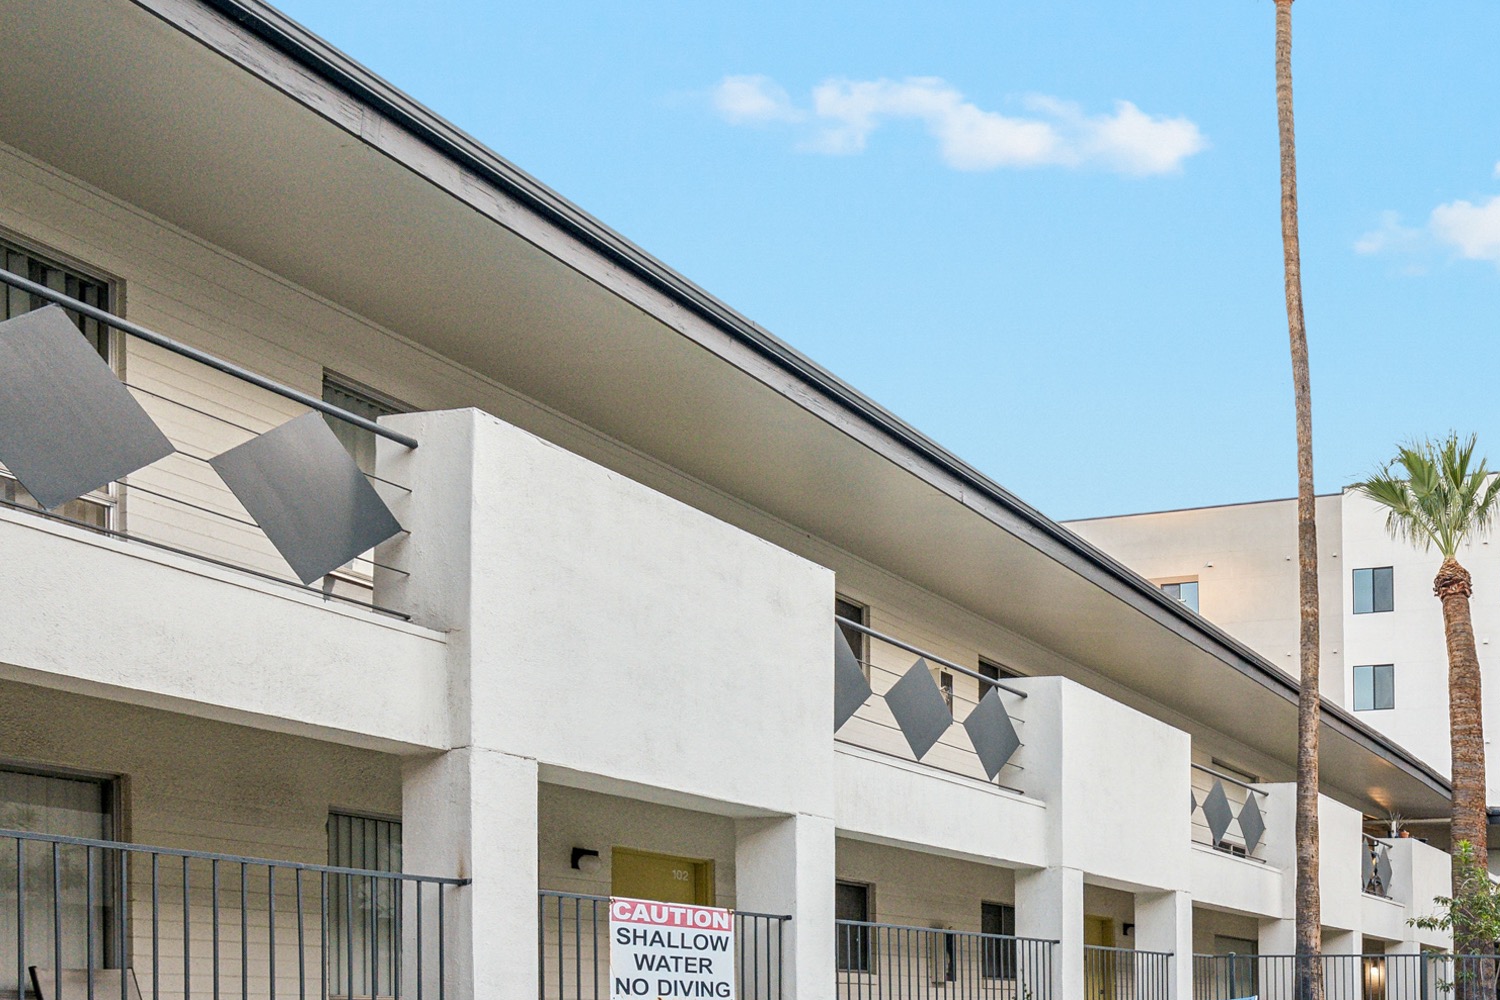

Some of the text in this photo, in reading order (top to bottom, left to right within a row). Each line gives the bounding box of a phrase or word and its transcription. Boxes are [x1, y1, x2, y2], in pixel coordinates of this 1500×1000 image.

[672, 870, 689, 881] 102
[612, 901, 729, 929] CAUTION
[616, 927, 729, 952] SHALLOW
[634, 953, 713, 974] WATER
[615, 977, 731, 998] NO DIVING
